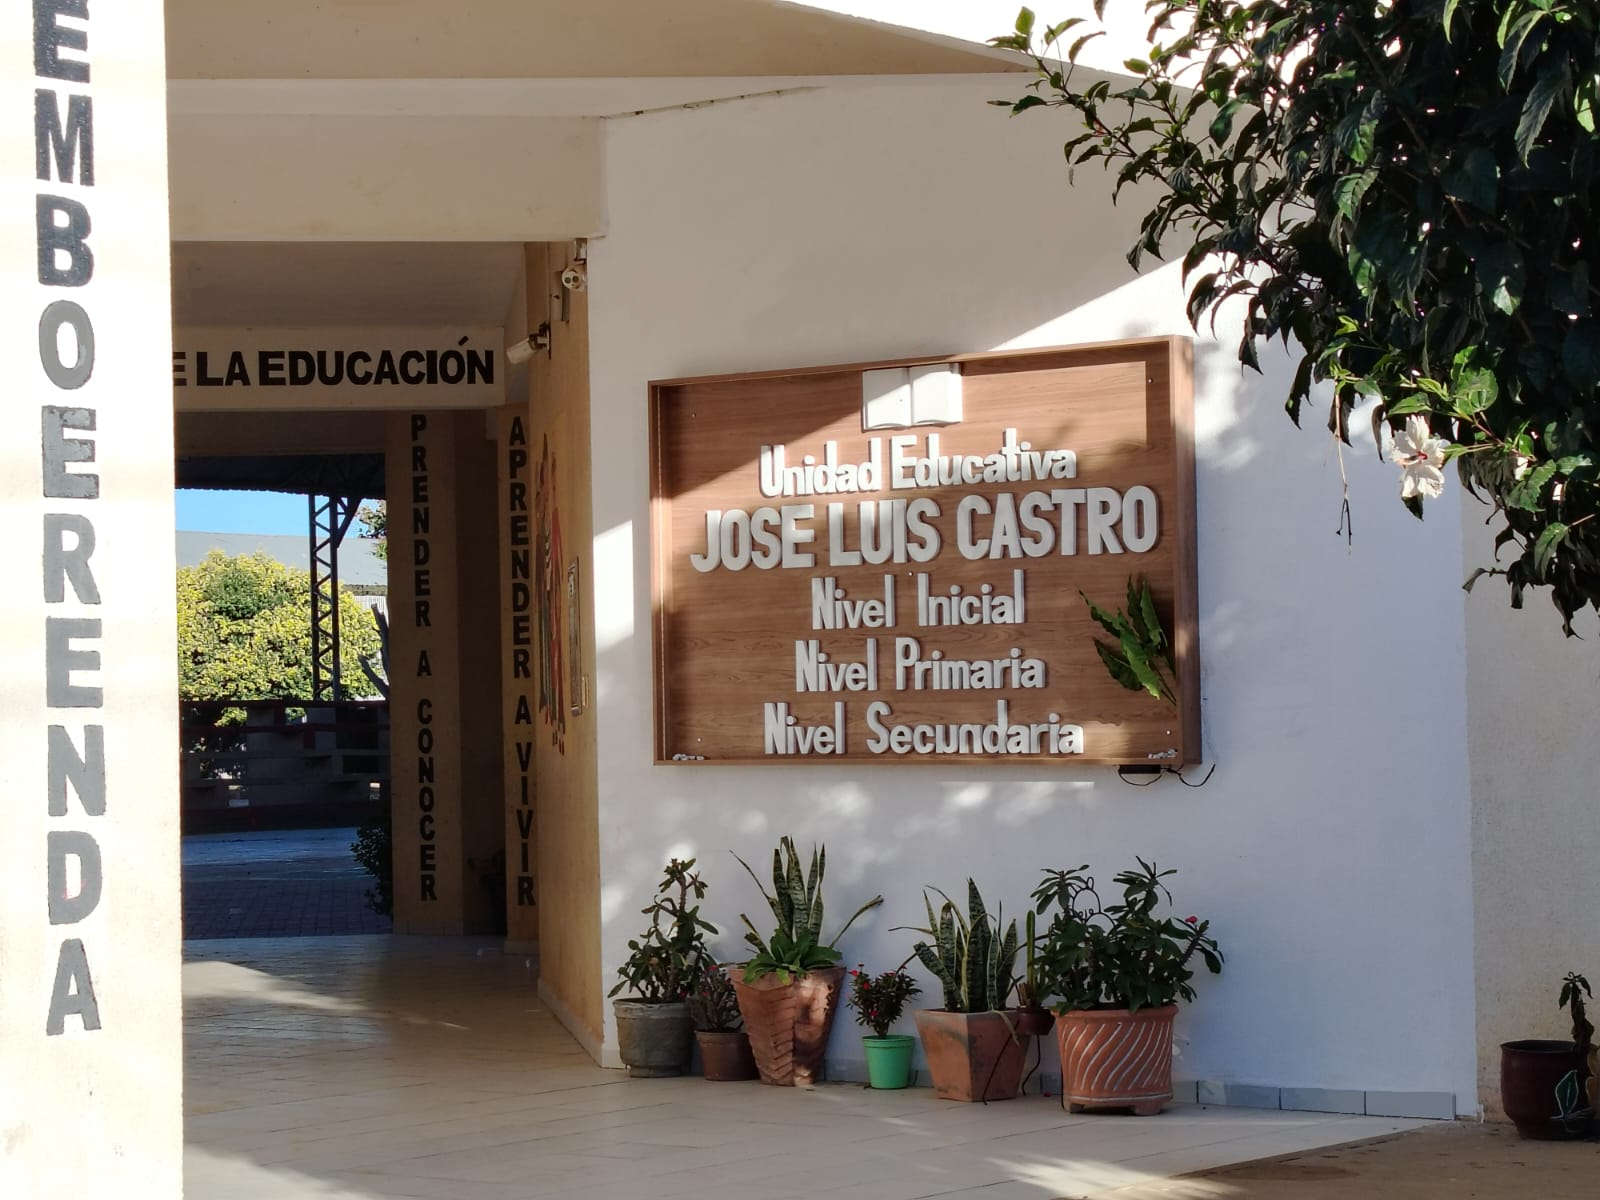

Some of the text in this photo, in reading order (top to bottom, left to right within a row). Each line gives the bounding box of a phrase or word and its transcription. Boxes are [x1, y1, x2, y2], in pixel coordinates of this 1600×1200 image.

[196, 351, 251, 386] LA
[258, 335, 494, 386] EDUCACIÓN
[760, 428, 1077, 498] Unidad Educativa
[690, 485, 1160, 573] JOSE LUIS CASTRO
[811, 569, 1025, 630] Nivel Inicial
[411, 414, 437, 901] PRENDER A CONOCER
[509, 416, 536, 906] APRENDER A VIVIR
[795, 637, 1046, 693] Nivel Primaria
[764, 699, 1085, 755] Nivel Secundaria
